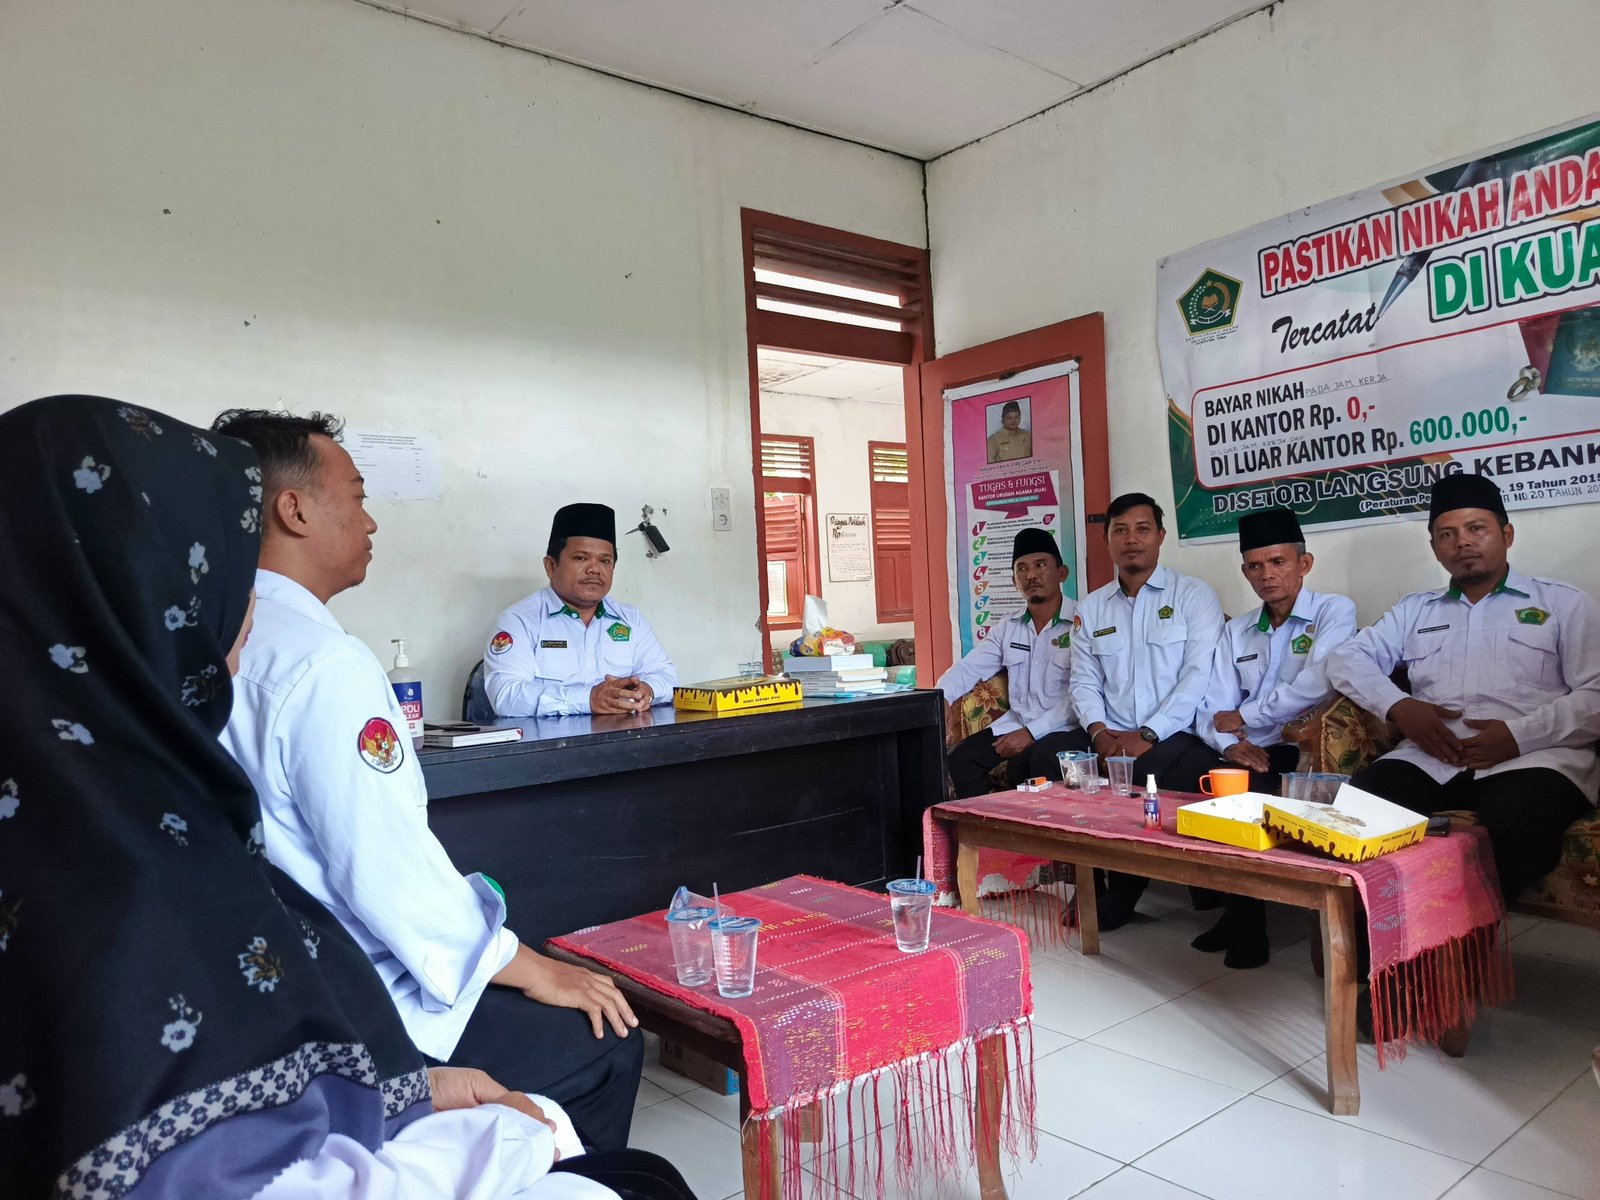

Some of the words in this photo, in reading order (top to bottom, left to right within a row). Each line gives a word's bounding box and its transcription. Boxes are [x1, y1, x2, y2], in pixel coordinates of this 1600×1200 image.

[1262, 211, 1395, 293] PASTIKAN
[1400, 183, 1501, 251] NIKAH
[1509, 150, 1600, 222] ANDA
[1432, 254, 1487, 317] DI
[1271, 302, 1378, 353] Tercatat
[1204, 392, 1253, 418] BAYAR
[1256, 381, 1305, 408] NIKAH
[1305, 383, 1331, 397] PADA
[1334, 379, 1354, 391] JAM
[1359, 374, 1388, 385] KERJA
[1206, 423, 1227, 447] DI
[1231, 407, 1305, 442] KANTOR
[1310, 403, 1342, 430] Rp.
[1346, 396, 1376, 423] 0,-
[1210, 454, 1230, 478] DI
[1234, 446, 1282, 475] LUAR
[1286, 431, 1366, 466] KANTOR
[1371, 427, 1404, 455] Rp.
[1409, 405, 1528, 446] 600.000,-
[978, 480, 1006, 493] TUGAS
[1008, 480, 1014, 489] &
[1015, 475, 1045, 488] FUNGSI
[978, 493, 996, 501] KANTOR
[996, 491, 1015, 499] URUSAN
[1015, 488, 1033, 496] AGAMA
[1213, 482, 1312, 514] DISETOR
[1317, 461, 1464, 504] LANGSUNG
[1360, 496, 1418, 512] (Peraturan
[1508, 482, 1524, 492] 19
[1526, 479, 1567, 490] Tahun
[1546, 486, 1582, 499] TAHUN
